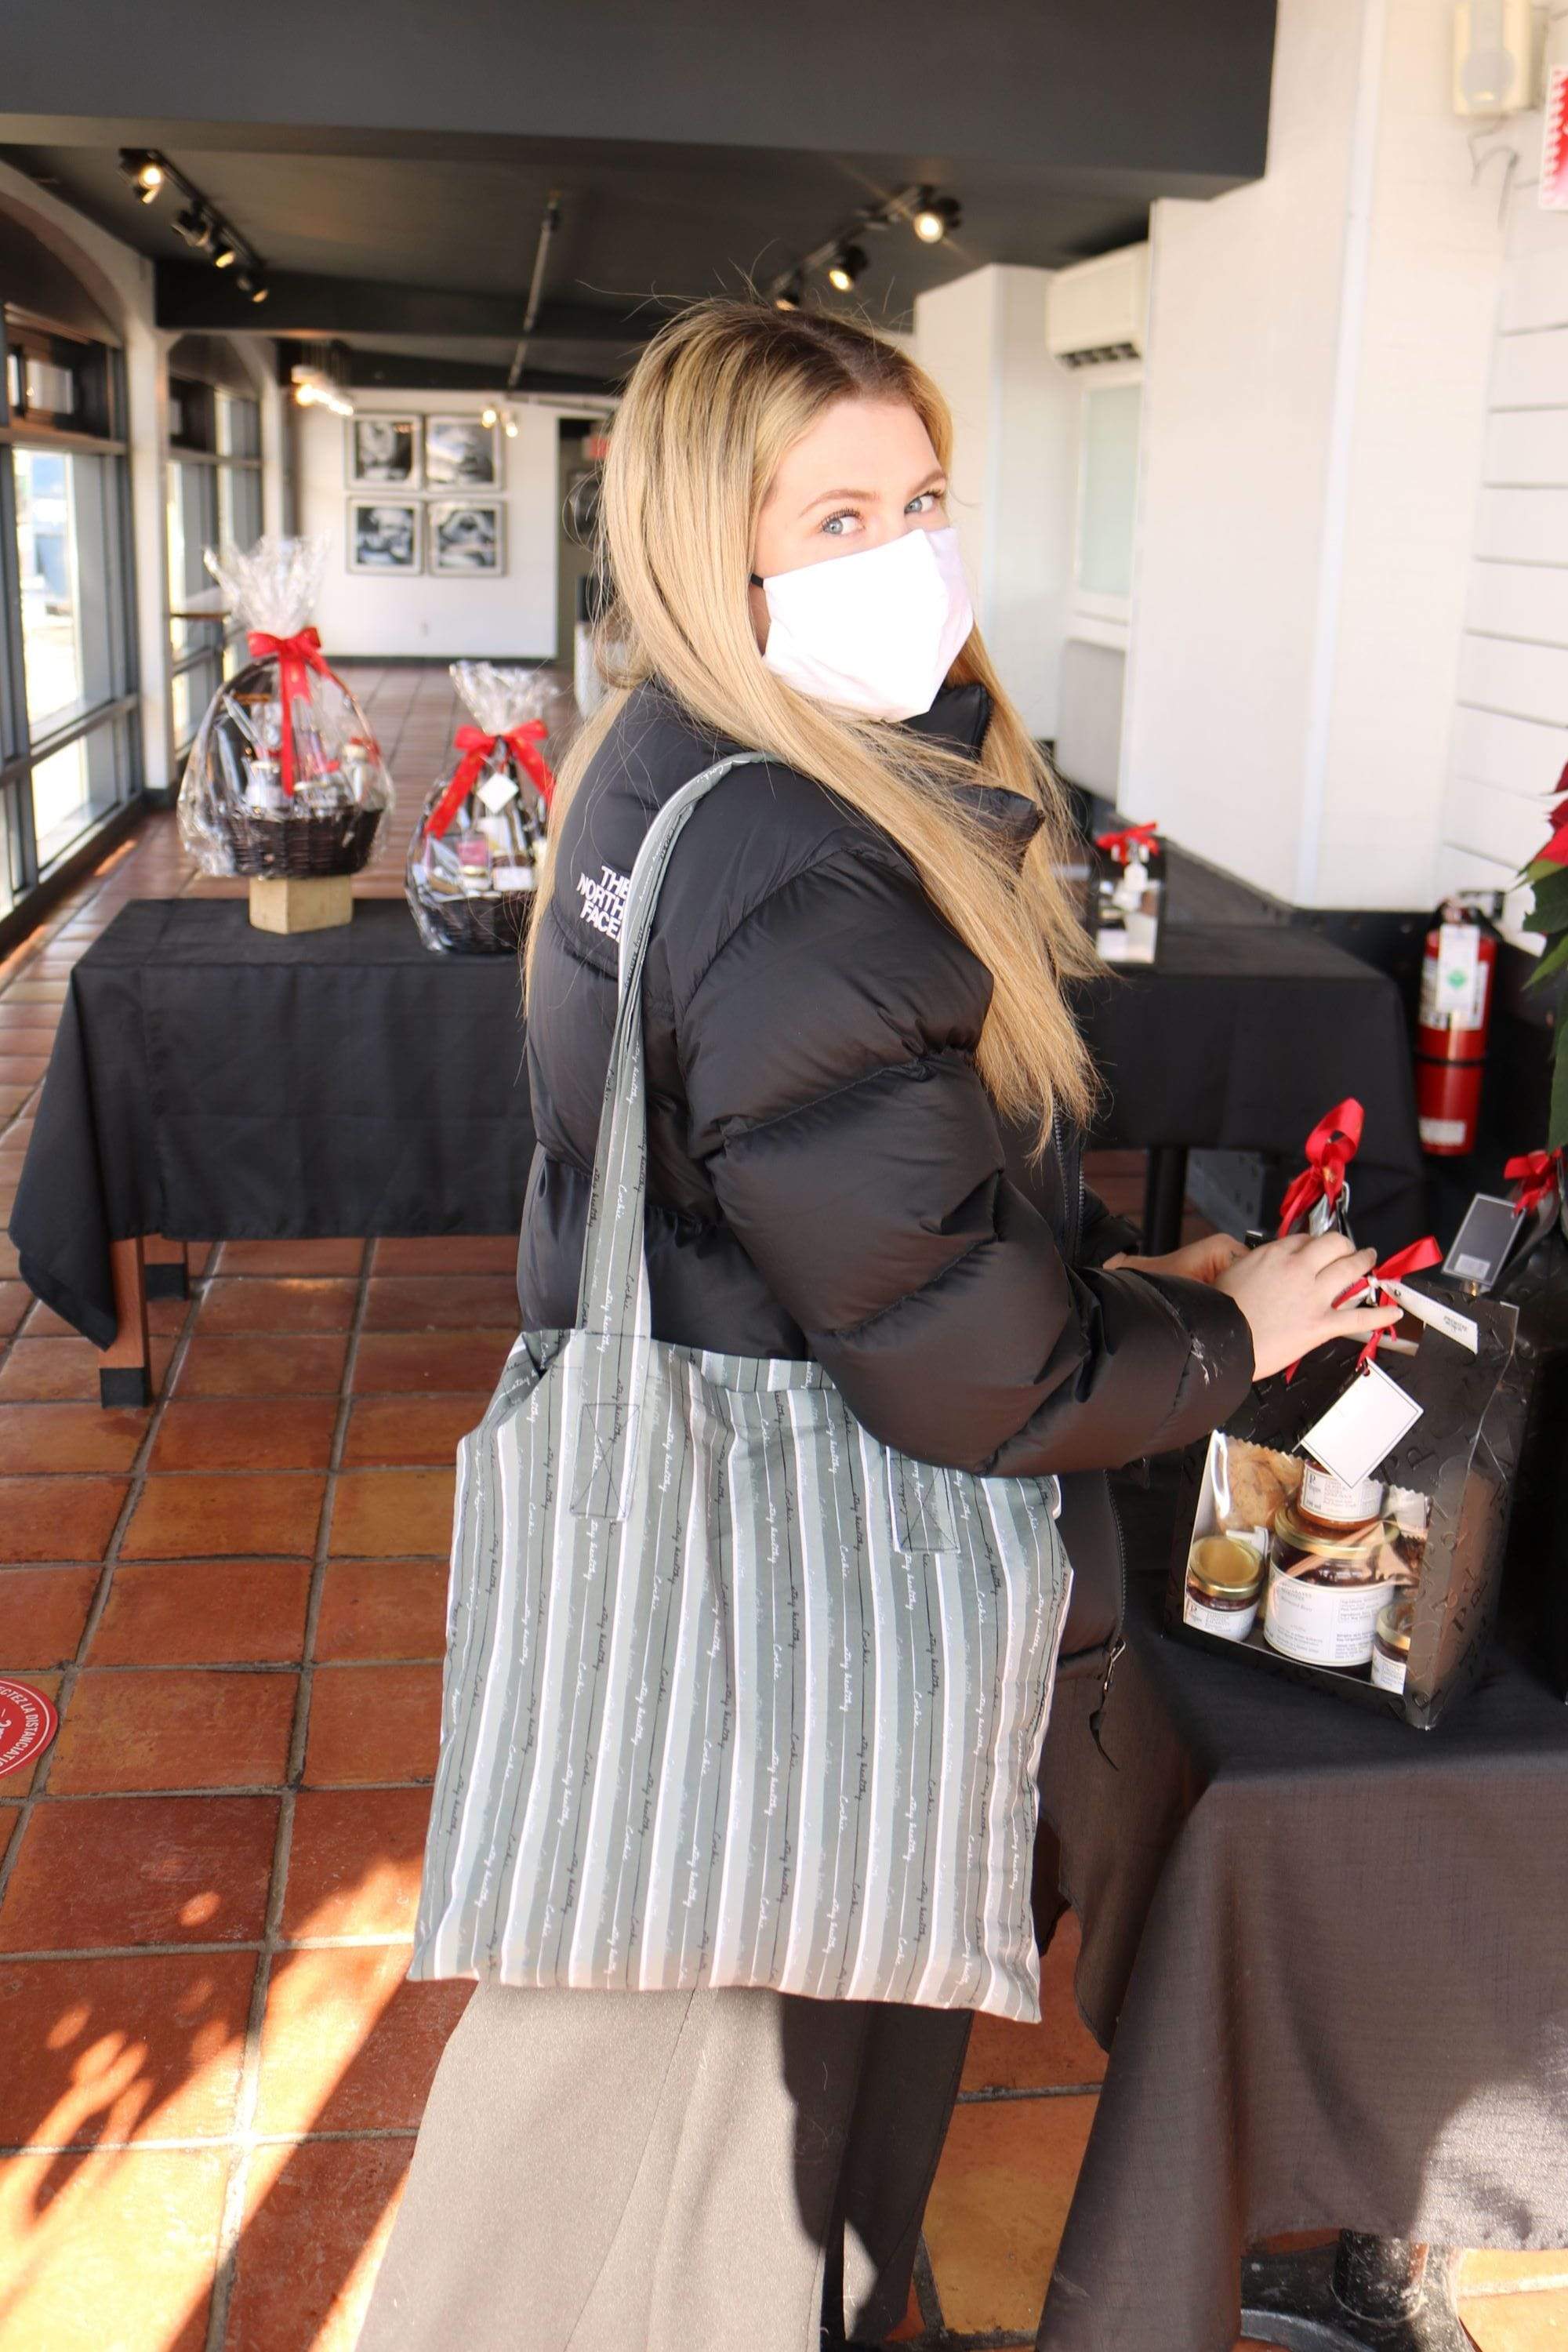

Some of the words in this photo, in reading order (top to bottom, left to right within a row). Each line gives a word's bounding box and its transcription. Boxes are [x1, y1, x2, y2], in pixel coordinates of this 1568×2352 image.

[576, 872, 627, 920] NORTH
[601, 865, 630, 899] THE
[580, 899, 621, 939] FACE
[20, 1702, 36, 1714] LA
